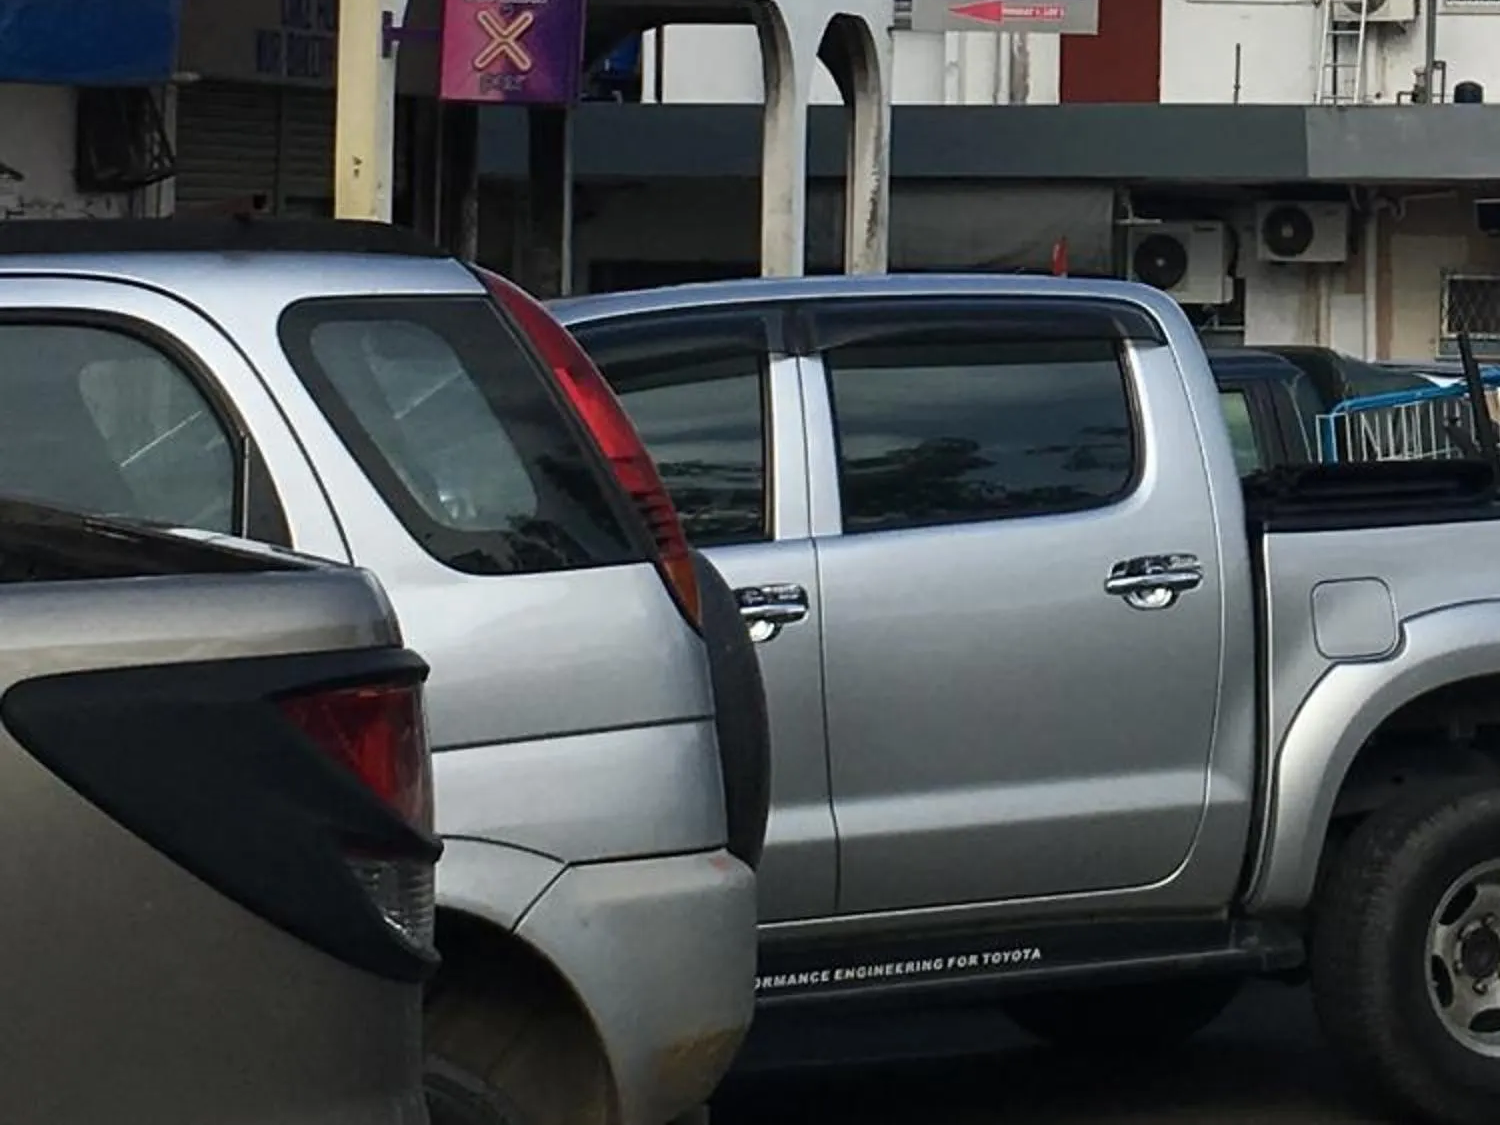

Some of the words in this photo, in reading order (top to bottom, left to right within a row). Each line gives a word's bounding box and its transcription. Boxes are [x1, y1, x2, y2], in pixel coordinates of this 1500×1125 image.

[833, 958, 944, 981] ENGINEERING
[947, 955, 979, 968] FOR
[982, 948, 1041, 965] TOYOTA
